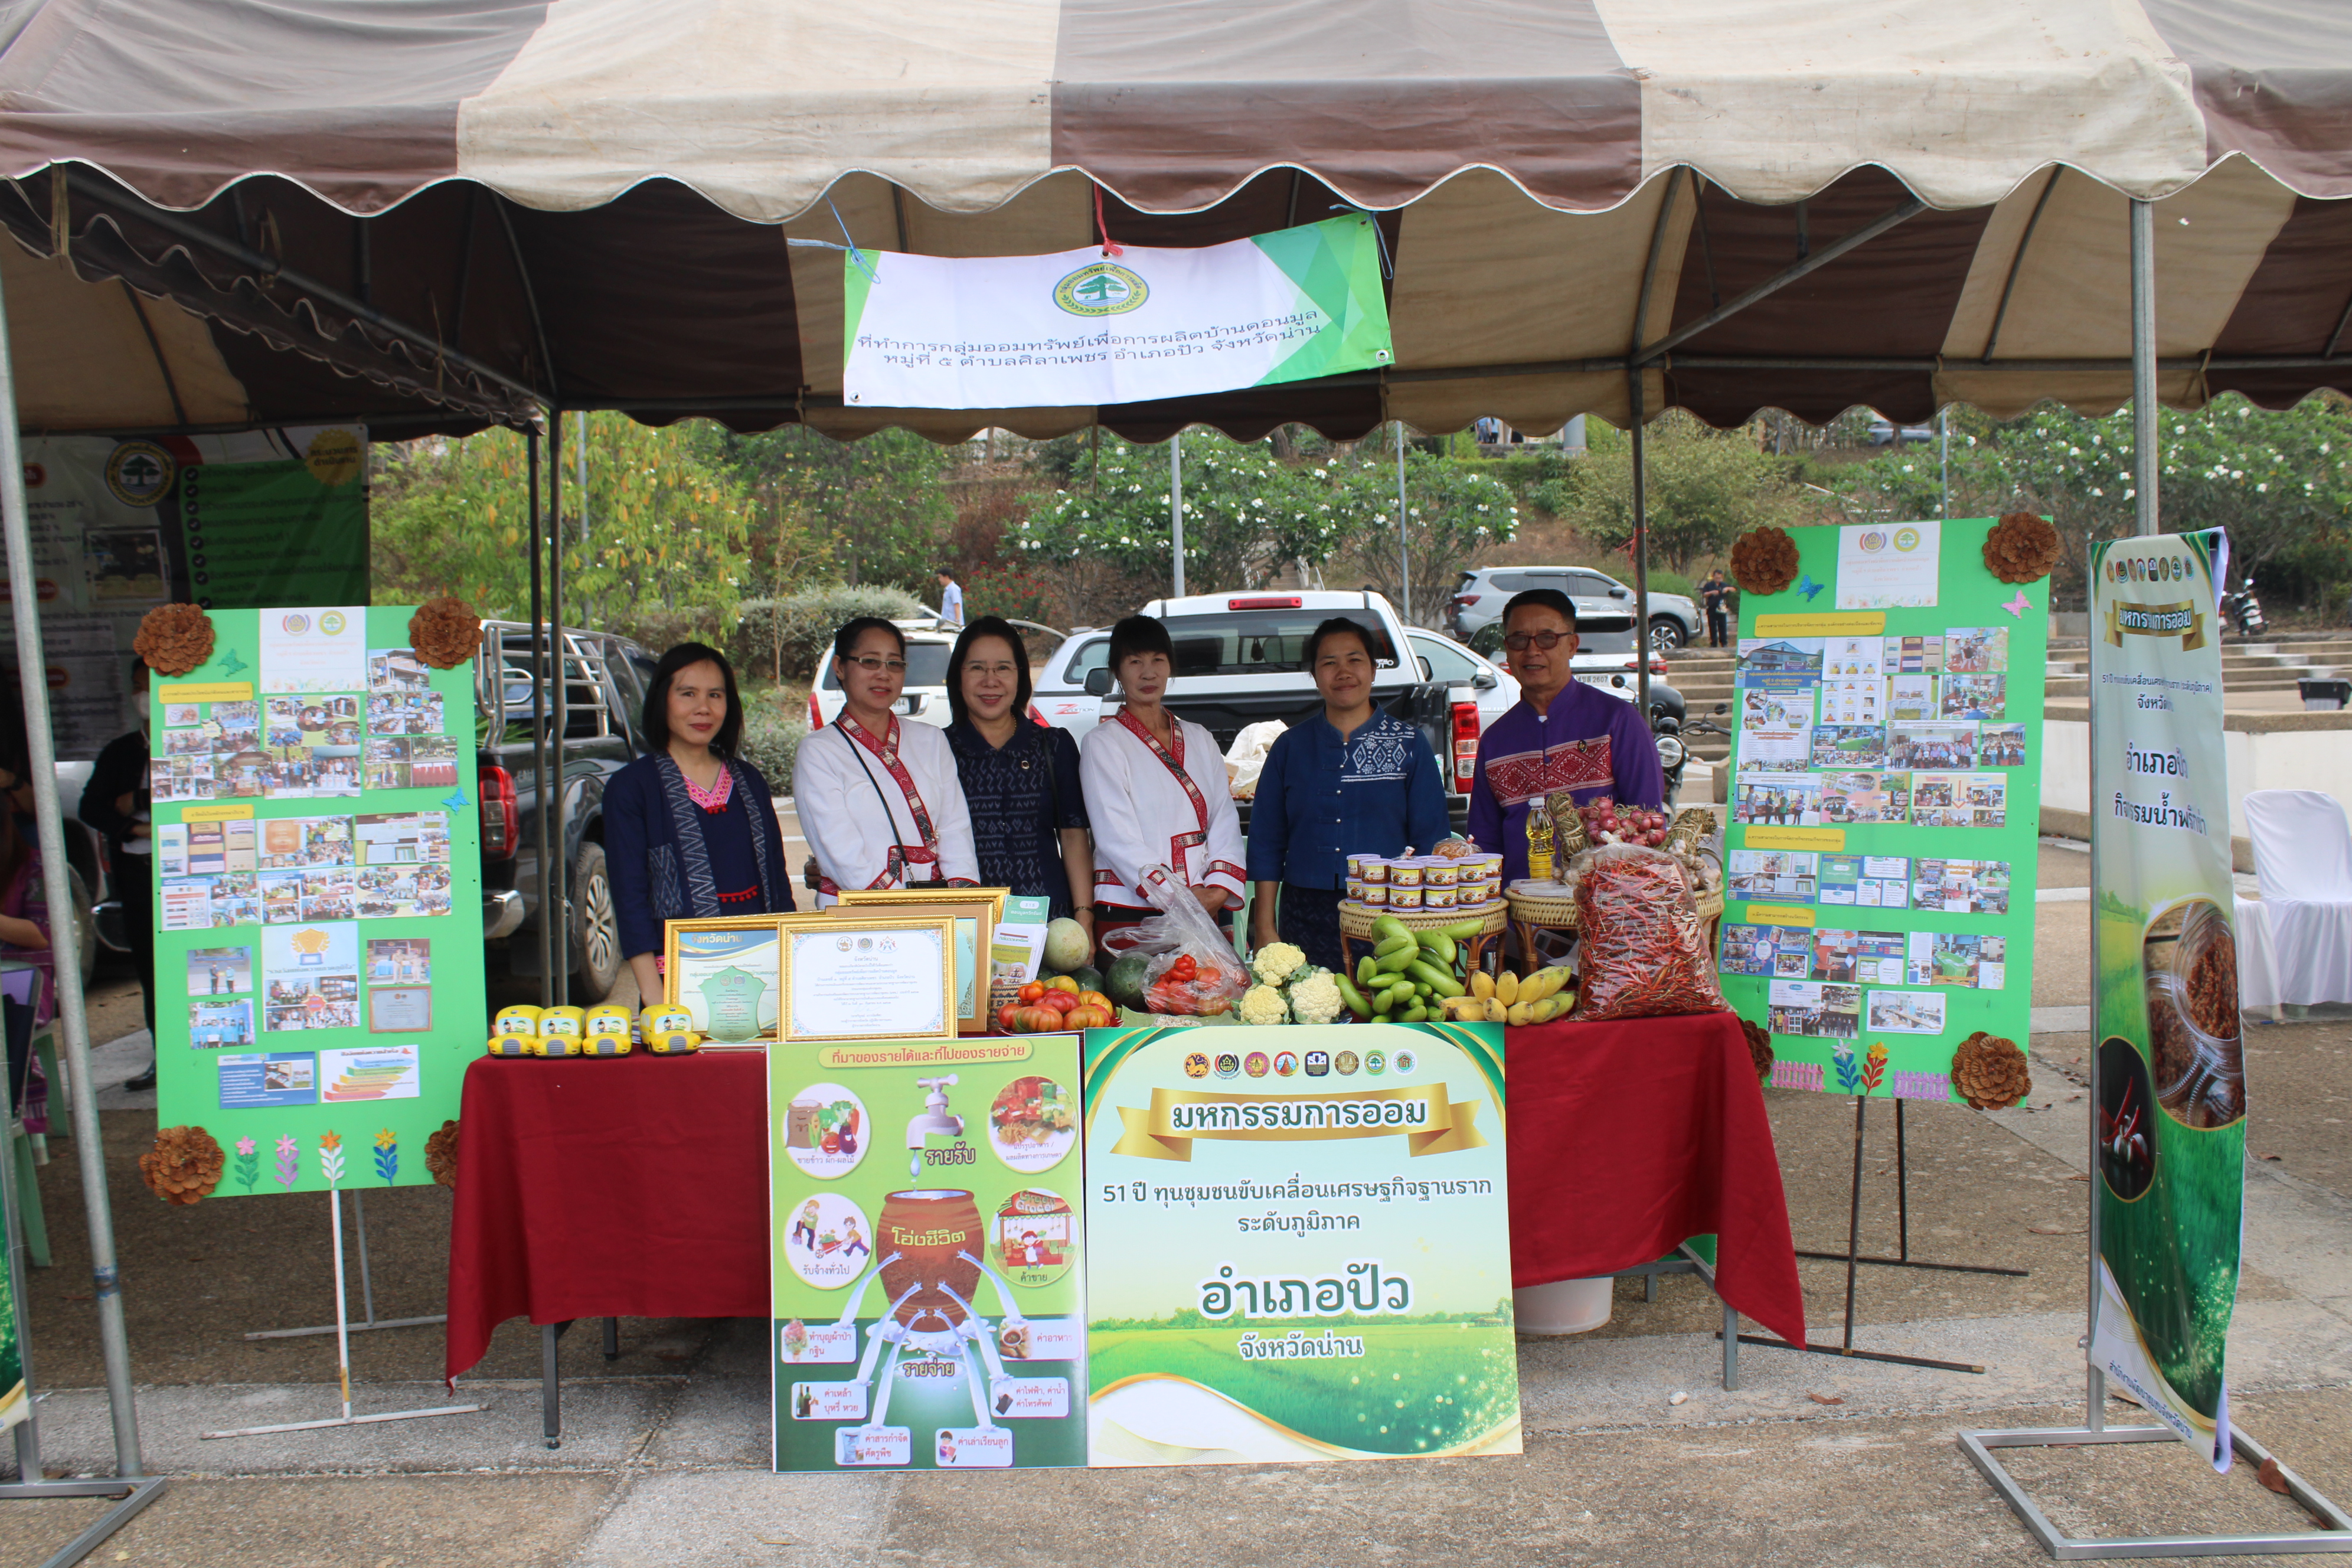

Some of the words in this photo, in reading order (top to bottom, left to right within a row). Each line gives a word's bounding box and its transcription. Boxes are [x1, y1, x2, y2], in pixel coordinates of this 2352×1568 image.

[857, 309, 1318, 355] ที่ทำการกลุ่มออมทรัพย์เพื่อการผลิตบ้านดอนมูล
[884, 352, 931, 369] หมู่ที่
[939, 358, 953, 367] ๕
[961, 350, 1108, 367] ตำบลศิลาเพชร
[1115, 344, 1204, 360] อำเภอปัว
[1210, 324, 1321, 351] จังหวัดน่าน
[313, 456, 356, 466] ดำเนินงาน
[2119, 607, 2193, 630] มหกรมการออม
[2102, 674, 2109, 683] 51
[2115, 792, 2207, 836] กิจรรมน้ำพริกข่า
[691, 932, 744, 944] จังหวัดน่าน
[831, 1044, 1025, 1064] ที่มาของรายได้และที่ไปของรายจ่าย
[1171, 1100, 1427, 1129] มหกรรมการออม
[1013, 1141, 1049, 1151] แปรรูปอาหาร
[796, 1155, 824, 1165] ขายข้าว
[825, 1154, 855, 1165] ผัก-ผลไม้
[925, 1141, 976, 1167] รายรับ
[1005, 1151, 1063, 1161] ผลผลิตทางการเกษตร
[1103, 1184, 1126, 1203] 51
[1133, 1181, 1146, 1201] ปี
[1152, 1172, 1492, 1208] ทุนชุมชนขับเคลื่อนเศรษฐกิจฐานราก
[1019, 1190, 1056, 1206] Green
[1015, 1200, 1056, 1213] Grocer
[1237, 1211, 1361, 1238] ระดับภูมิภาค
[891, 1226, 966, 1247] โอ่งชีวิต
[802, 1263, 851, 1276] รับจ้างทั่วไป
[1019, 1272, 1048, 1283] ค้าขาย
[1201, 1263, 1410, 1315] อำเภอปัว
[808, 1331, 852, 1344] ทำบุญผ้าป่า
[1036, 1332, 1074, 1344] ค่าอาหาร
[808, 1345, 825, 1358] กฐิน
[1239, 1332, 1364, 1359] จังหวัดน่าน
[902, 1358, 955, 1378] รายจ่าย
[824, 1389, 852, 1399] ค่าเหล้า
[1015, 1386, 1045, 1397] ค่าไฟฟ้า,
[1047, 1382, 1066, 1396] ค่าน้ำ
[823, 1400, 841, 1415] บุหรี่
[843, 1404, 859, 1413] หวย
[1015, 1397, 1053, 1409] ค่าโทรศัพท์
[864, 1433, 909, 1446] ค่าสารกำจัด
[957, 1436, 1010, 1449] ค่าเล่าเรียนลูก
[864, 1447, 892, 1460] ศัตรูพืช
